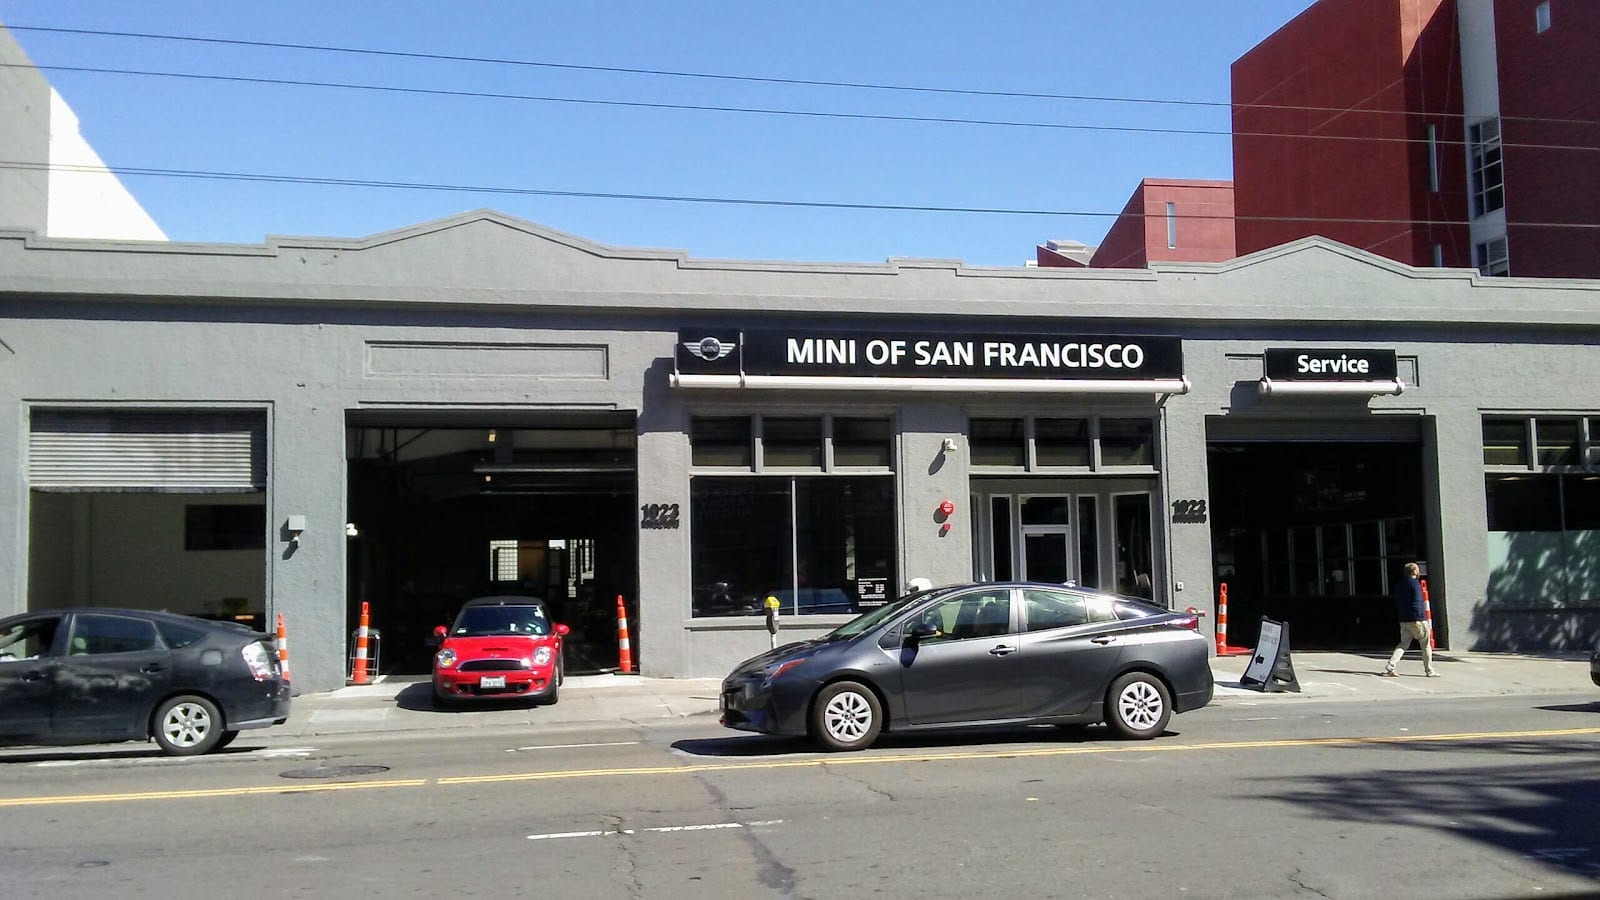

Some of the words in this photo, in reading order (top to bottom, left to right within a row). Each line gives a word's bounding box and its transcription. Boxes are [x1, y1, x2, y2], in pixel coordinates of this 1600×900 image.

[787, 338, 856, 365] MINI
[865, 339, 907, 365] OF
[914, 340, 974, 367] SAN
[983, 342, 1144, 370] FRANCISCO
[1297, 354, 1370, 374] Service
